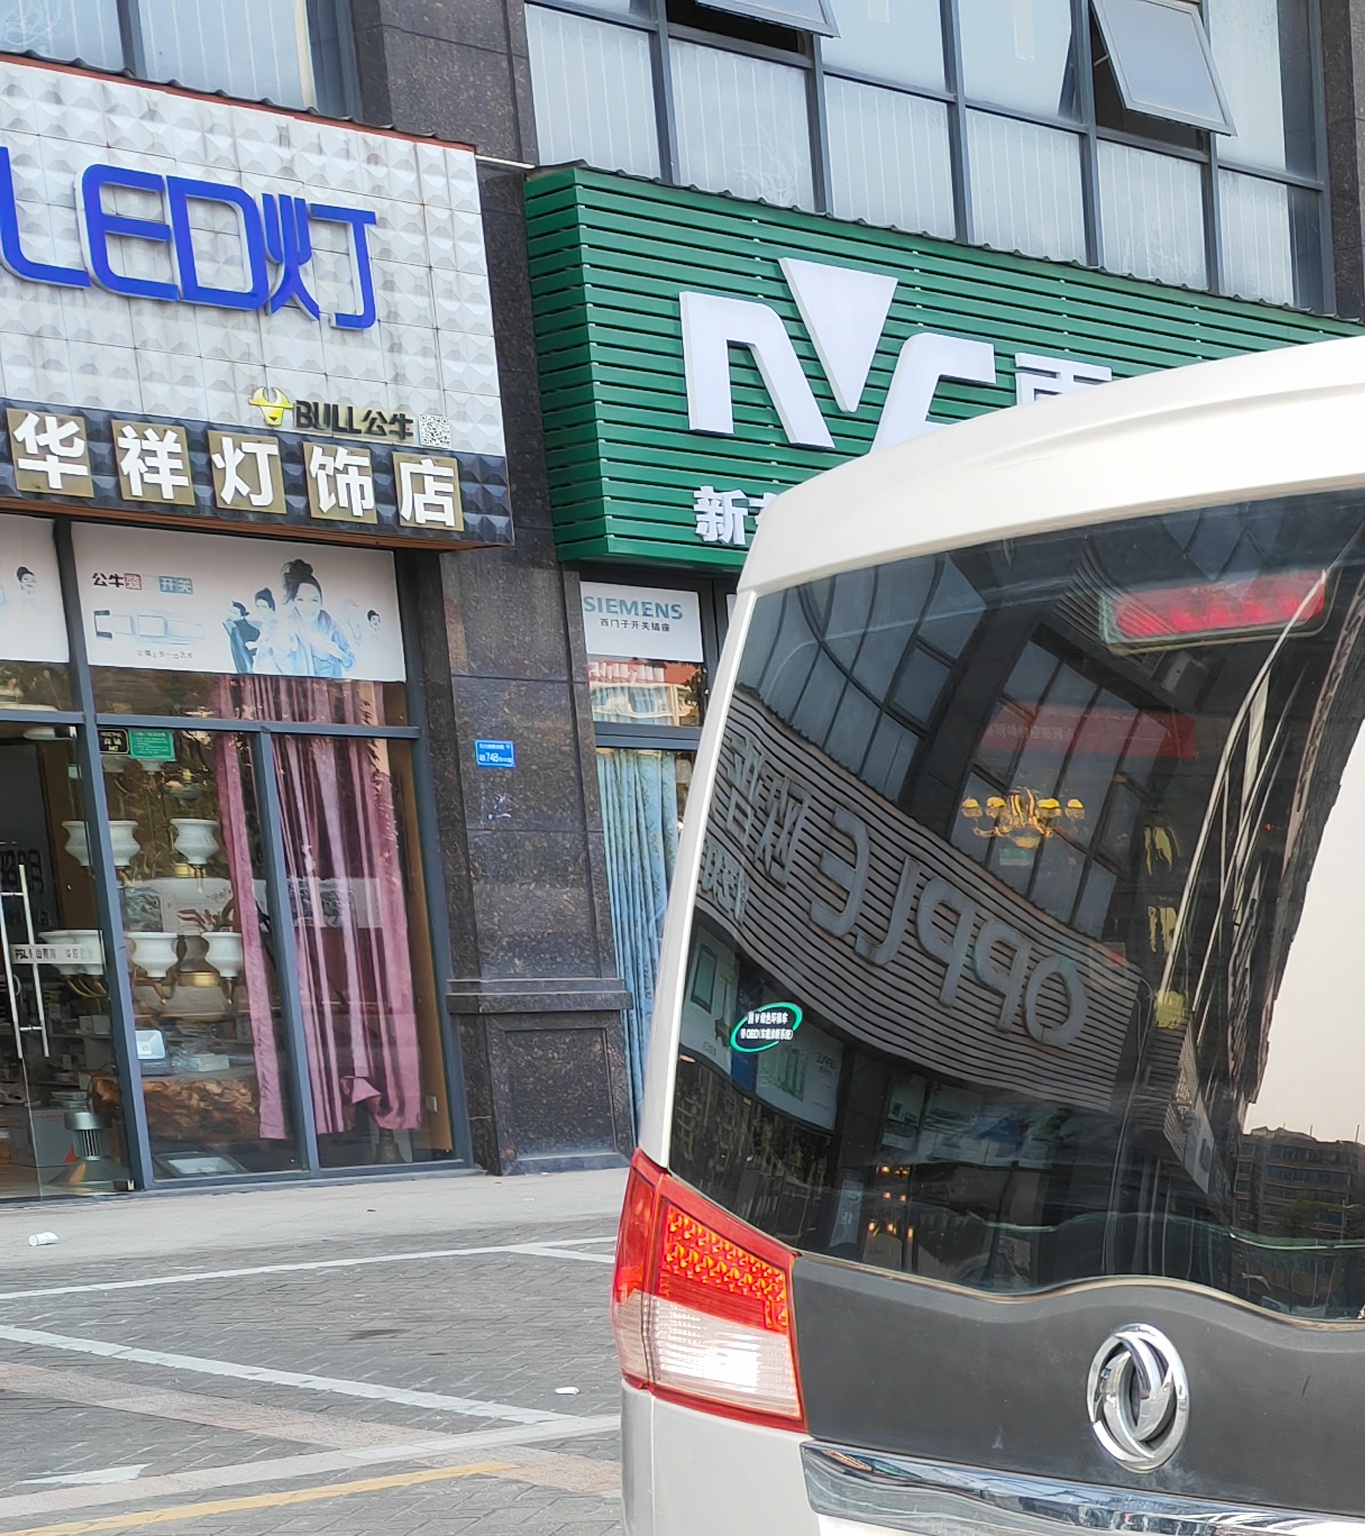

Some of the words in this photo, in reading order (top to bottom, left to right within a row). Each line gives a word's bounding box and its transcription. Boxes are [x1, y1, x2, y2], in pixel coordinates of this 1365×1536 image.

[295, 401, 362, 434] BULL
[362, 409, 414, 440] 公牛
[13, 412, 457, 527] 华祥灯饰店
[583, 595, 684, 620] SIEMENS
